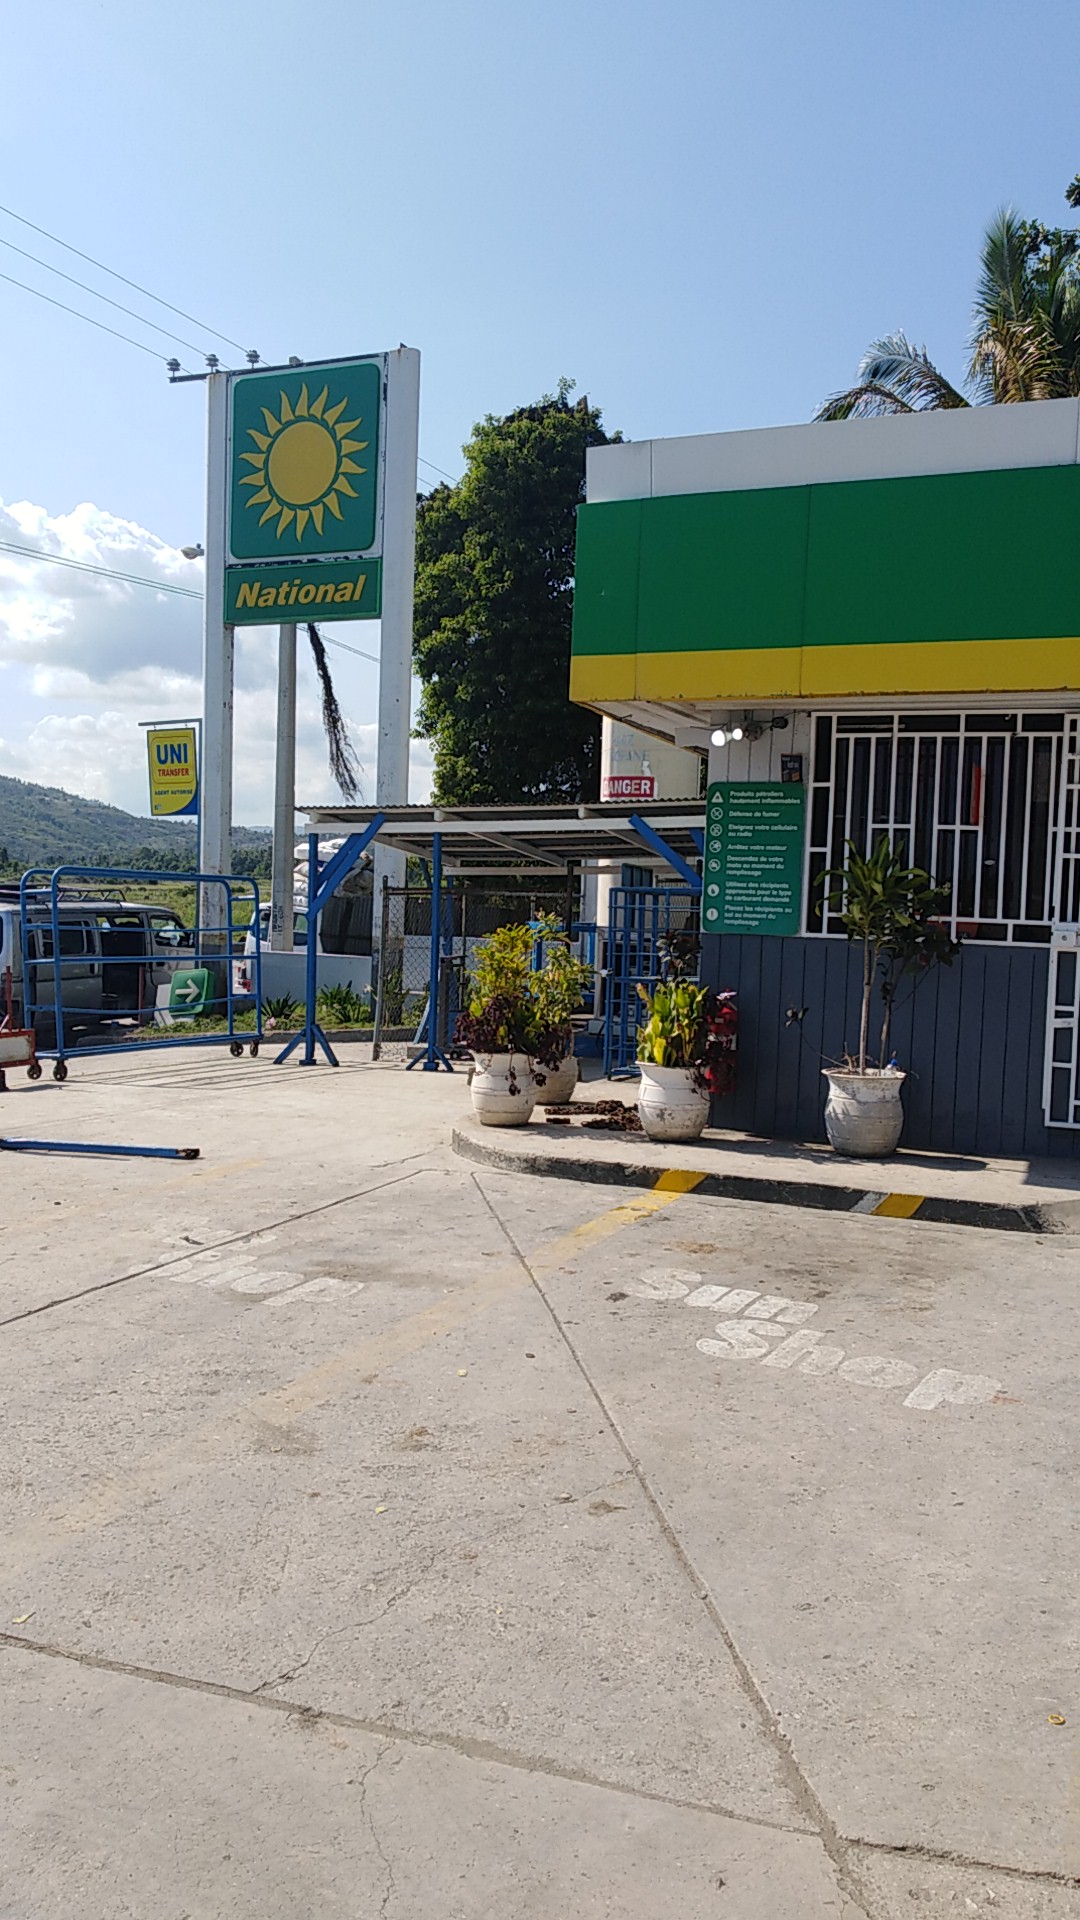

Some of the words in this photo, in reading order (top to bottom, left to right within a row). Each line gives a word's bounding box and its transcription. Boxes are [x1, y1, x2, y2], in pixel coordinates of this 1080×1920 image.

[236, 574, 366, 609] National
[156, 743, 189, 765] UNI
[158, 768, 189, 777] TRANSFER
[604, 779, 651, 795] DANGER
[622, 1267, 820, 1325] Sun
